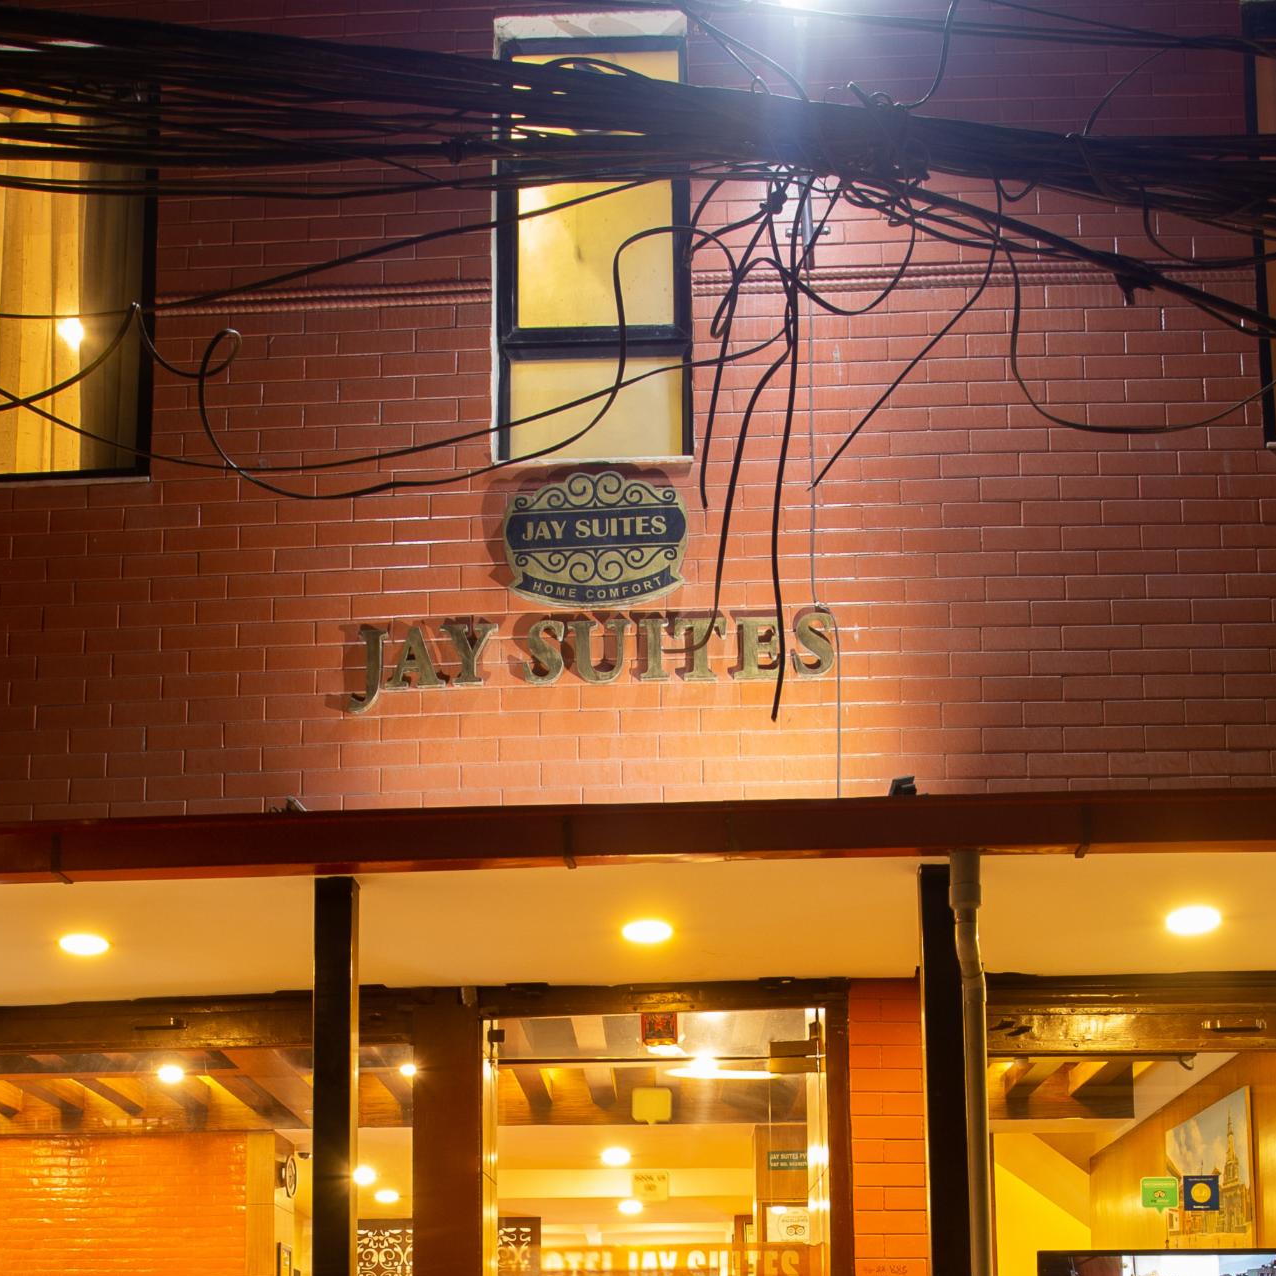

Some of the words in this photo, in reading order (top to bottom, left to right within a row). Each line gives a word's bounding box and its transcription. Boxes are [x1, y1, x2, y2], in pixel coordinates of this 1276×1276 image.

[522, 519, 566, 542] JAY
[575, 515, 668, 539] SUITES
[532, 580, 577, 599] HOME
[585, 576, 663, 599] COMFORT
[350, 622, 500, 714] JAY
[523, 611, 837, 686] SUITES
